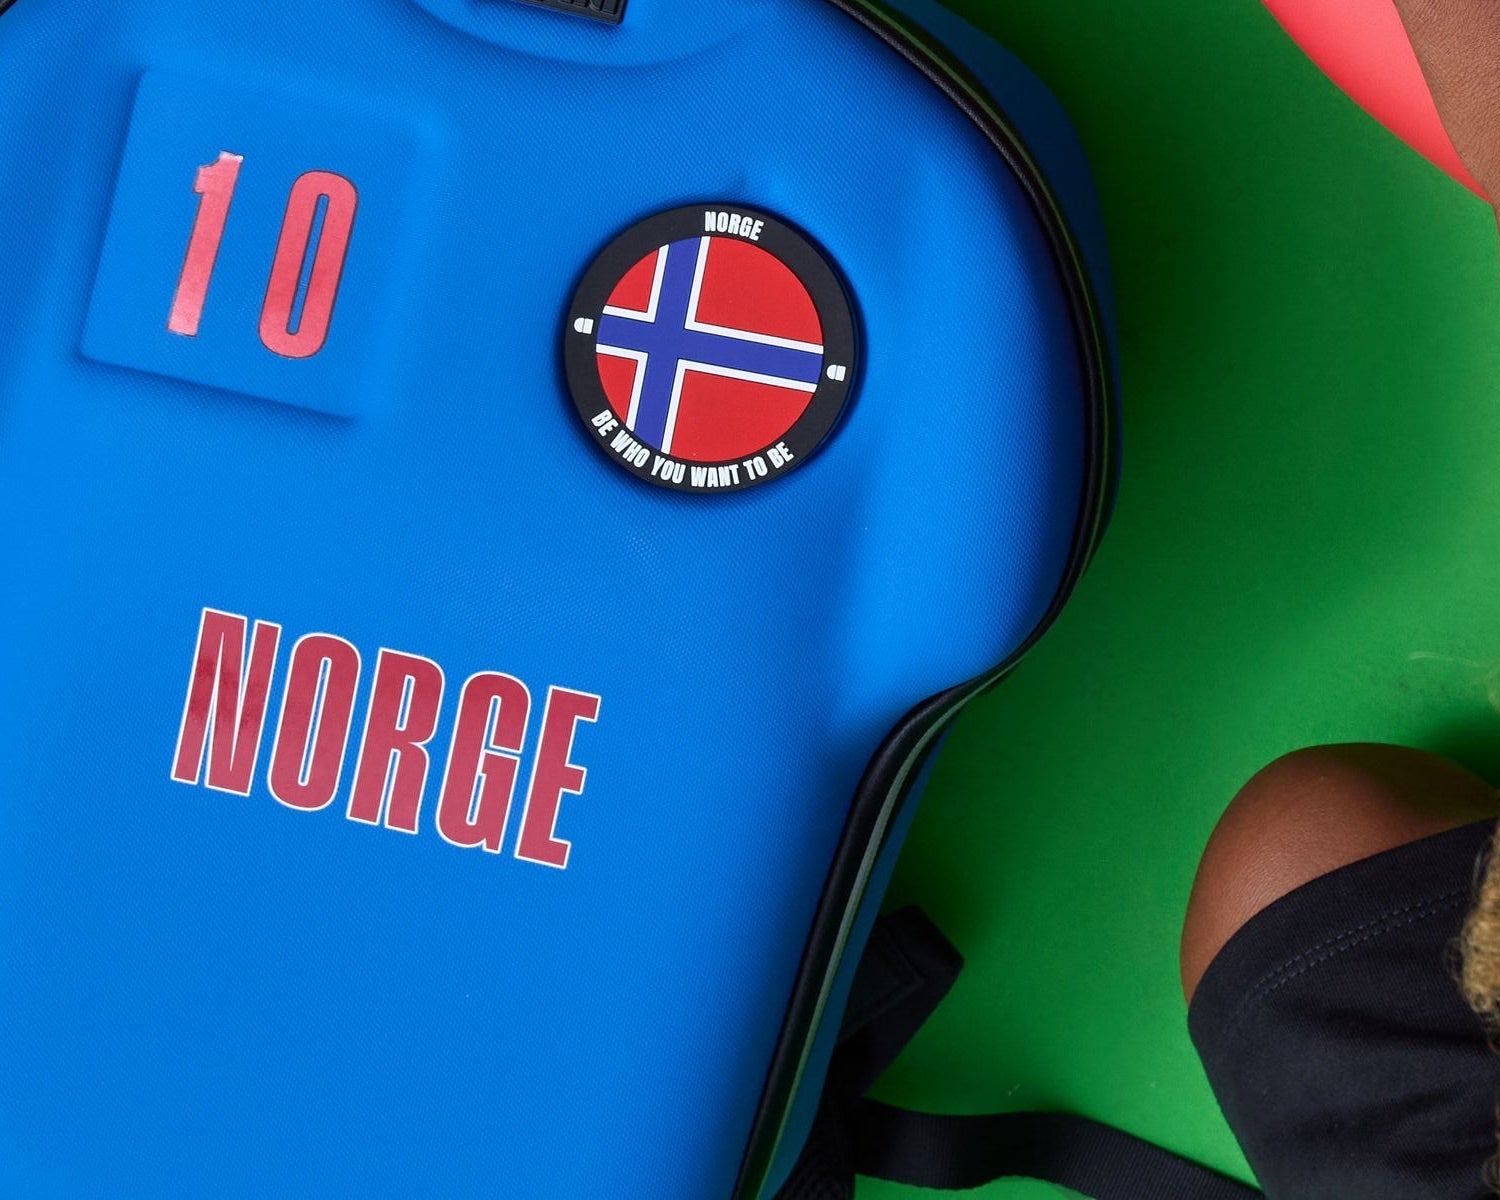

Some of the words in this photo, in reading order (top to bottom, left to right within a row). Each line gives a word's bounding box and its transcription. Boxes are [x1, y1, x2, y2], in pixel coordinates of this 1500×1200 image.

[704, 210, 764, 241] NORGE
[591, 409, 619, 437] BE
[610, 430, 650, 468] WHO
[650, 455, 686, 484] YOU
[690, 464, 740, 488] WANT
[743, 452, 768, 480] TO
[766, 441, 794, 469] BE
[170, 607, 602, 870] NORGE
